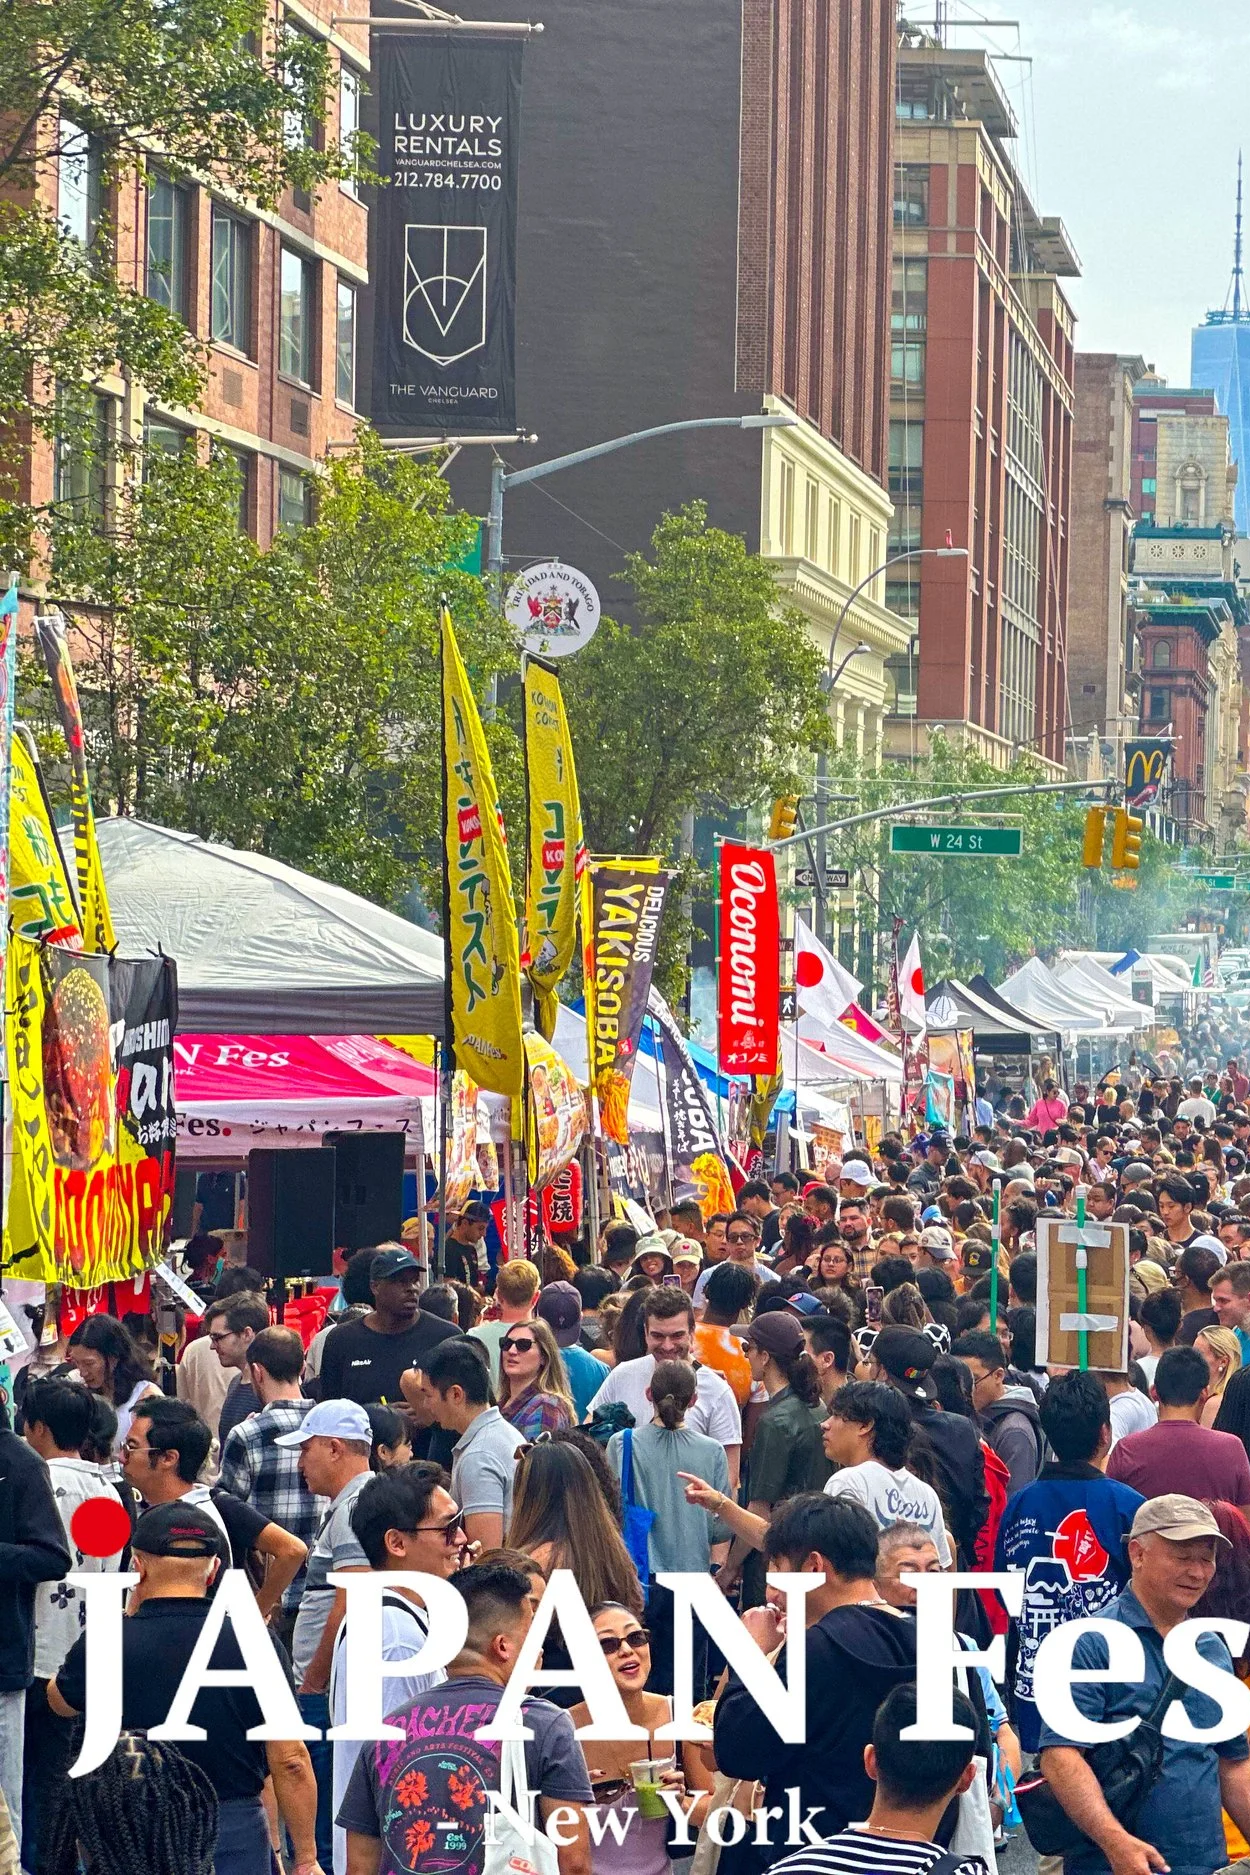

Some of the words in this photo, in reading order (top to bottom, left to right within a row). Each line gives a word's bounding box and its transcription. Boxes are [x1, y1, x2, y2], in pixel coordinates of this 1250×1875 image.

[395, 112, 503, 133] LUXURY
[394, 135, 502, 156] RENTALS
[395, 158, 502, 169] VANGUARDCHELSEA.COM
[394, 171, 502, 190] 212.784.7700
[389, 384, 416, 396] THE
[419, 385, 498, 398] VANGUARD
[512, 572, 548, 608] TRIIDAD
[549, 572, 570, 582] AND
[571, 578, 595, 613] TOBAGO
[930, 833, 941, 848] W
[946, 834, 963, 849] 24
[968, 835, 983, 849] St
[632, 885, 665, 963] DELICIOUS
[729, 861, 767, 1028] Oconomi
[596, 884, 645, 1066] YAKISOBA
[213, 1044, 290, 1067] Fes
[726, 1052, 769, 1064] オコノミ
[444, 1841, 467, 1851] 1999
